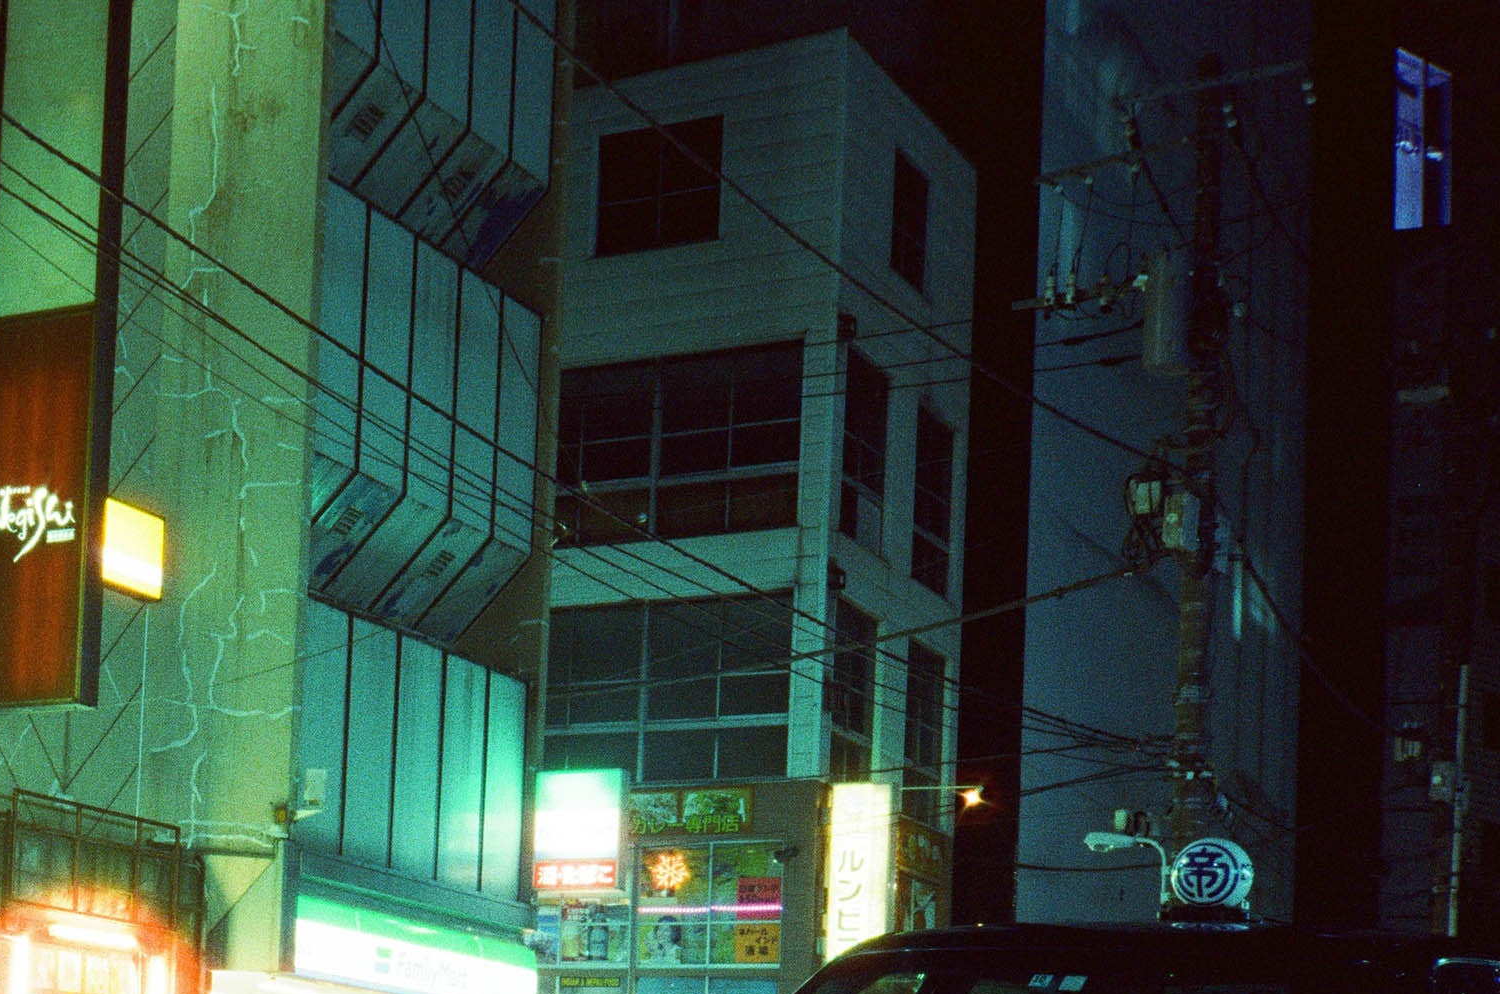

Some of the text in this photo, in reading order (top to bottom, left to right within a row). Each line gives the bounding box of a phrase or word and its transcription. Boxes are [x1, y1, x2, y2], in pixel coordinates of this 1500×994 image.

[631, 813, 740, 835] カレー専門店
